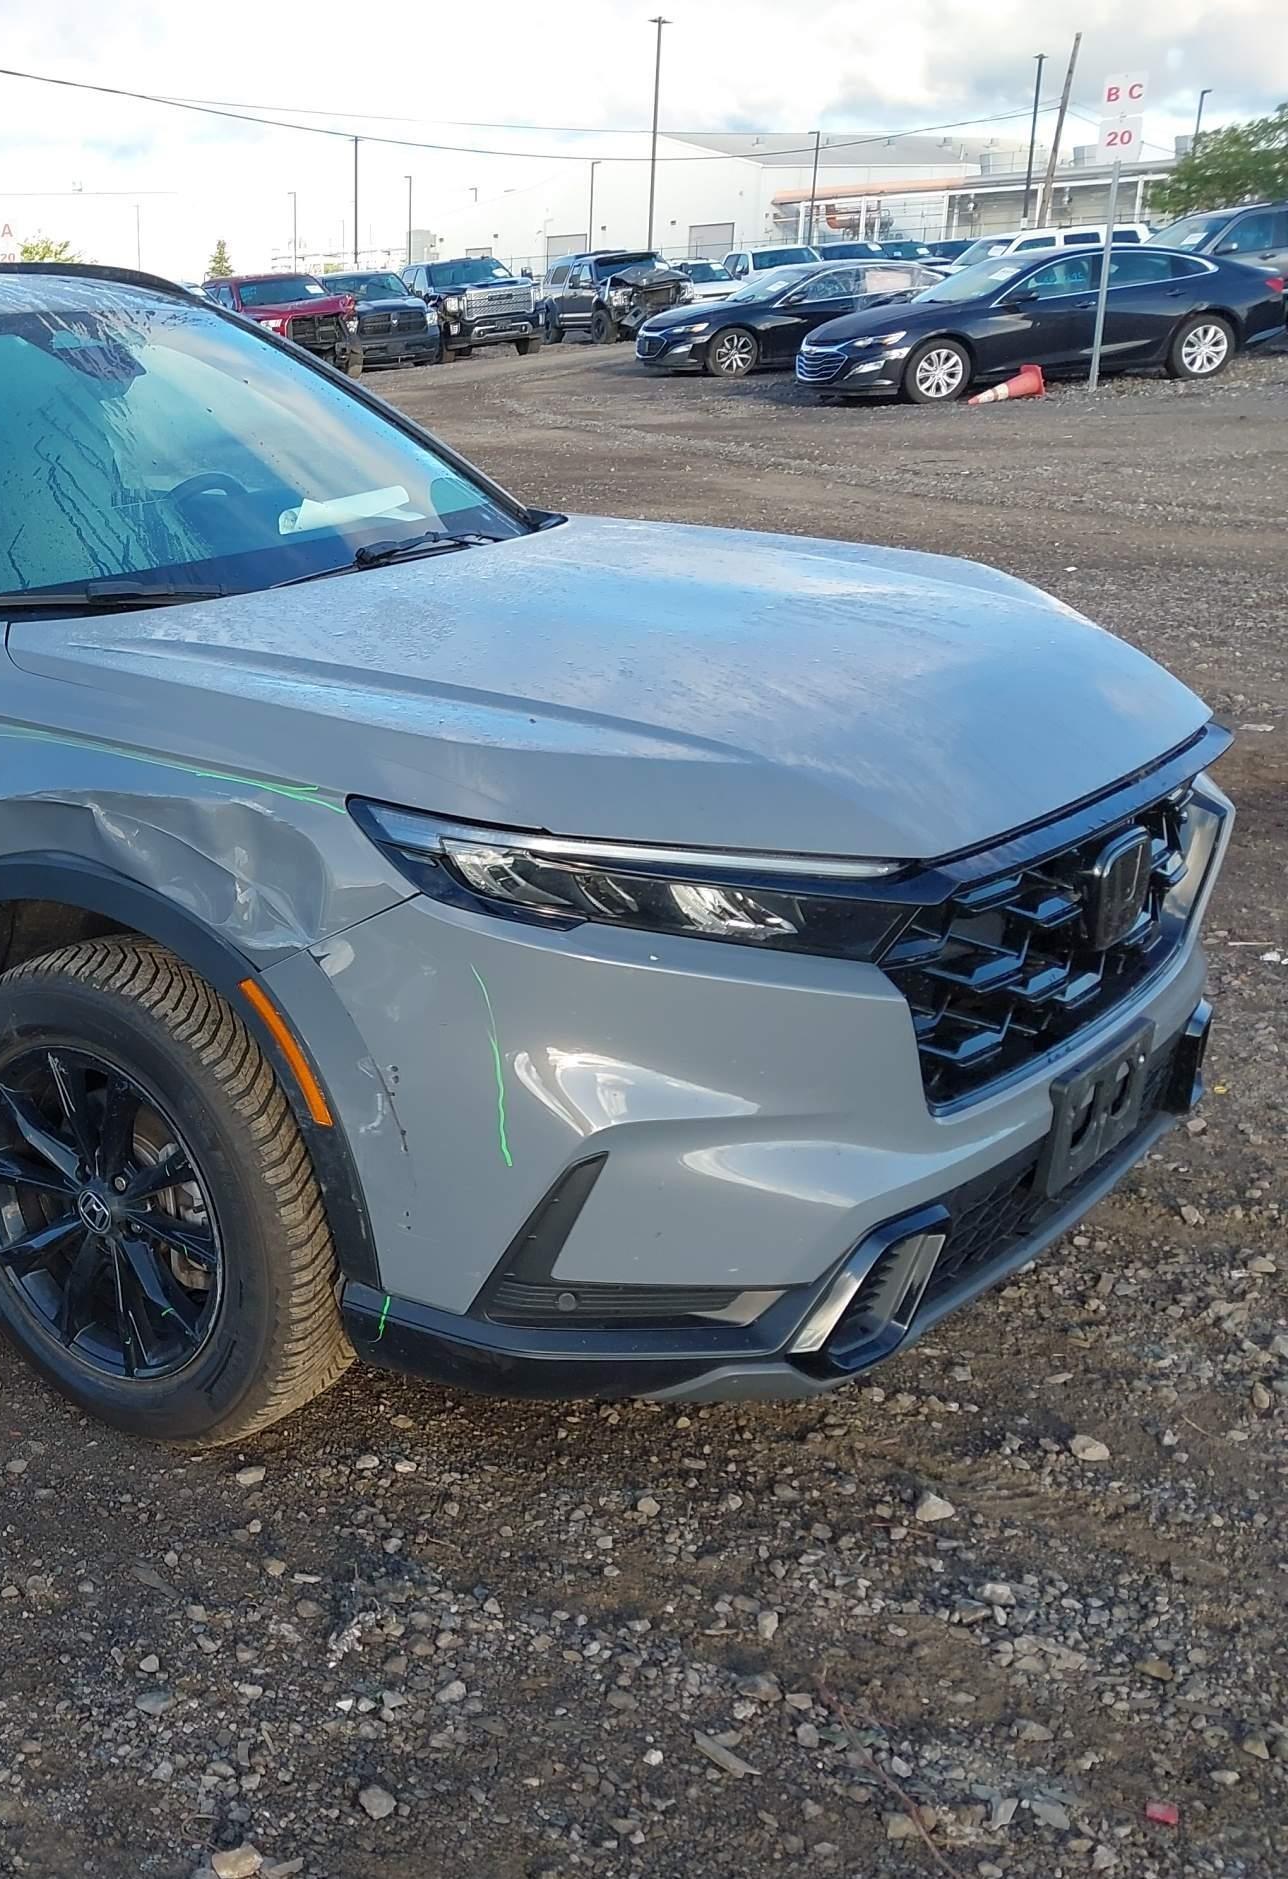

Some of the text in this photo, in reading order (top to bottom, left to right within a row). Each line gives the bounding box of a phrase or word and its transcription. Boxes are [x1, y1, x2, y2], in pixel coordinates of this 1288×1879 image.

[1106, 83, 1144, 103] B C
[1106, 129, 1133, 147] 20
[1, 223, 14, 238] A
